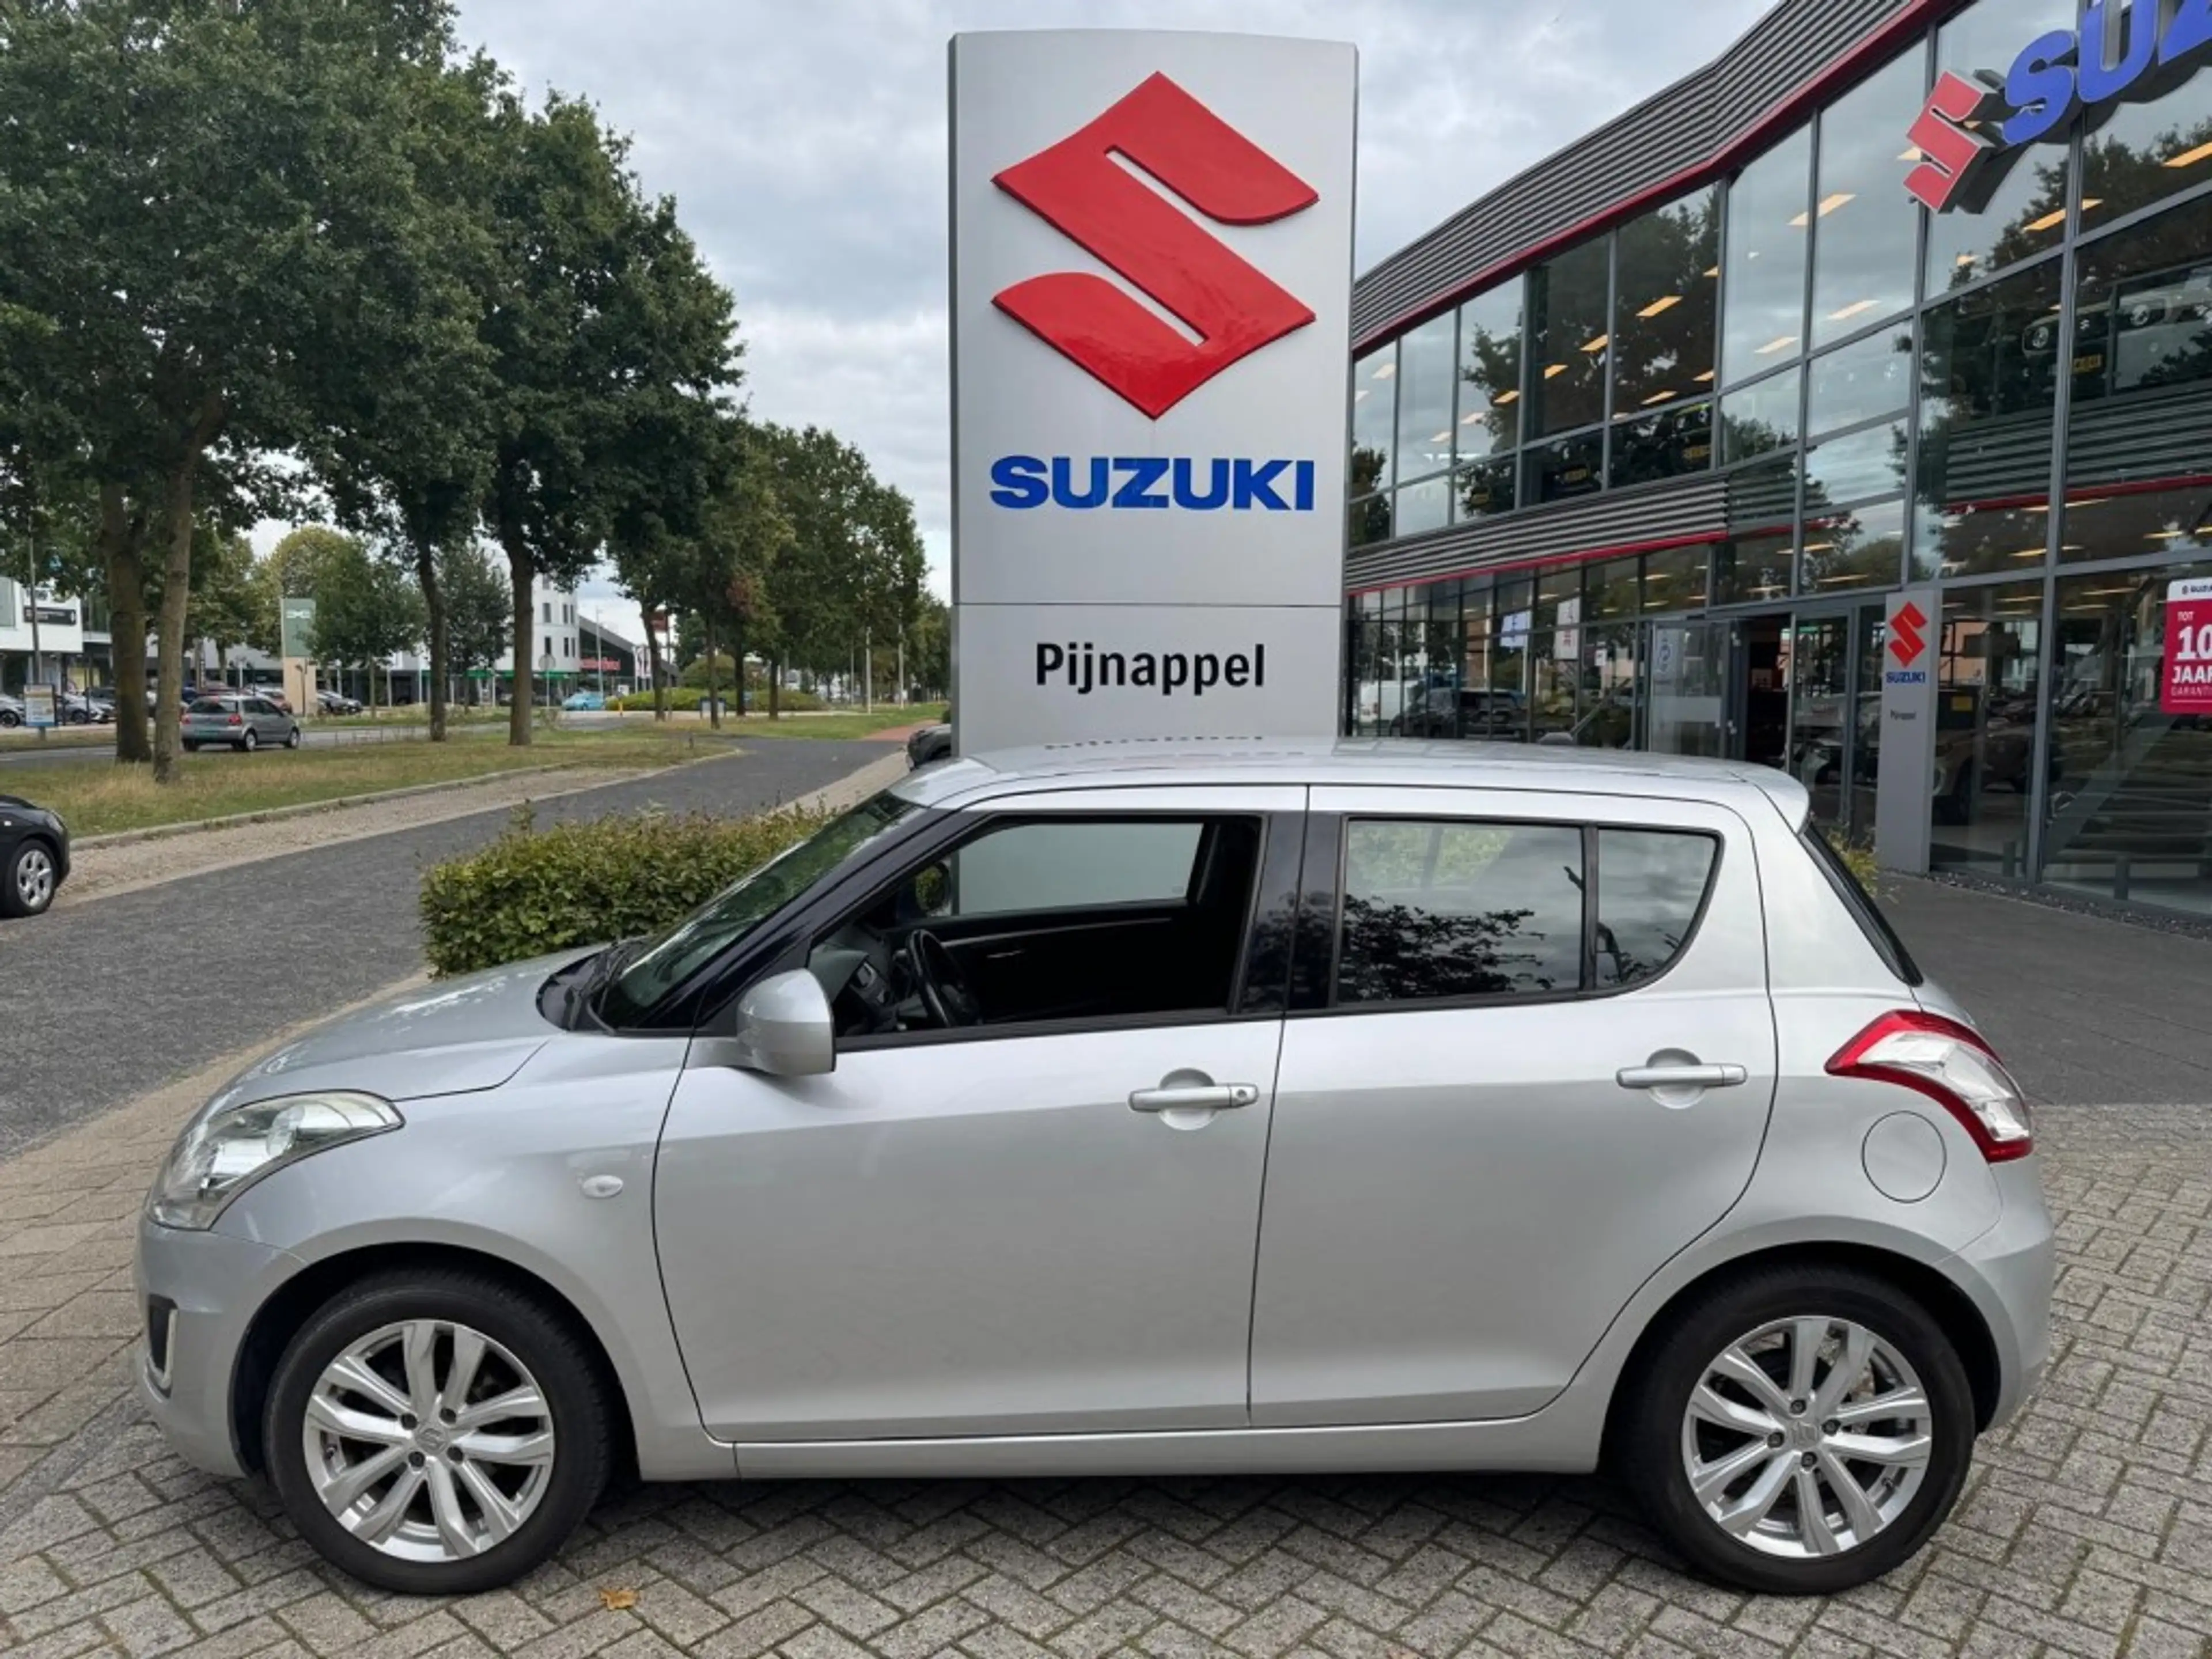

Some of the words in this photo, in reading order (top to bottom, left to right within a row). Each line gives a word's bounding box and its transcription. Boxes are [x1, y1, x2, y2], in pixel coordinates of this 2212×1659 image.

[990, 455, 1315, 510] SUZUKI
[2177, 611, 2194, 622] TOT
[2177, 624, 2212, 660] 10
[1036, 642, 1265, 696] Pijnappel
[1887, 672, 1926, 683] SUZUKI
